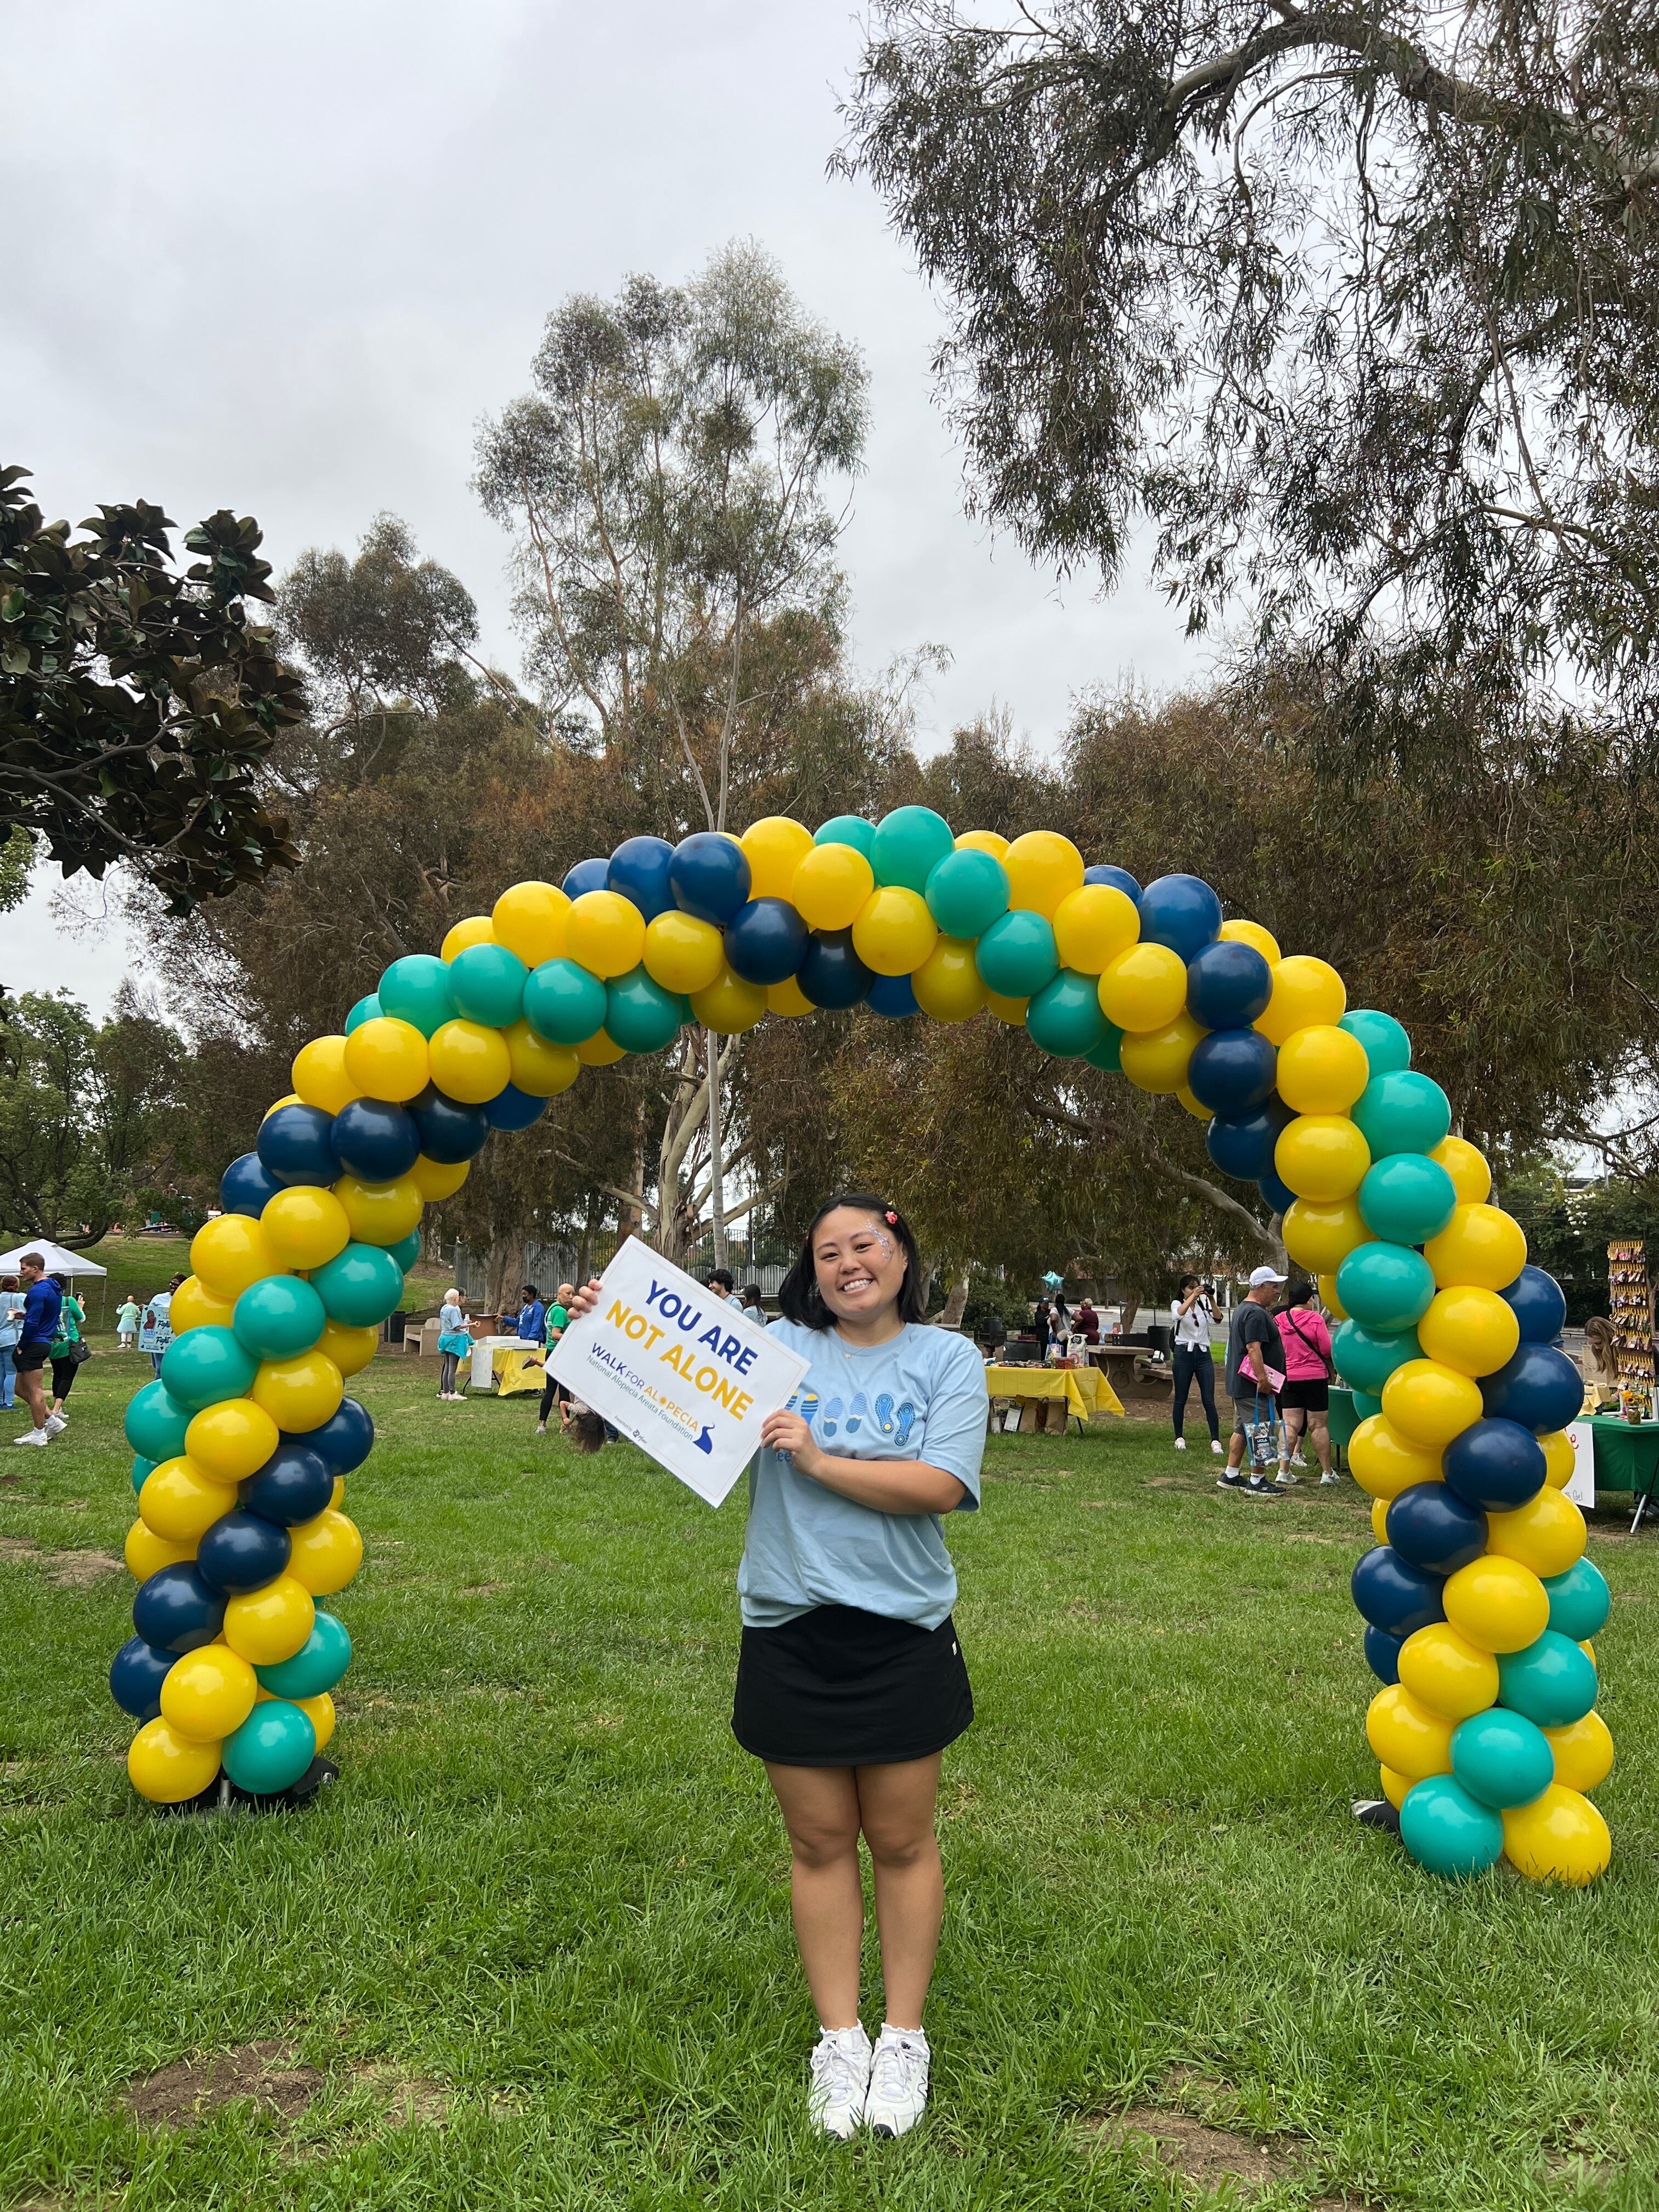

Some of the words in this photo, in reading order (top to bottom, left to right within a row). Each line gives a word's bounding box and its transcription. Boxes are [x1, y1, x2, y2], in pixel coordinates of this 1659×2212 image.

[592, 1342, 627, 1375] WALK
[625, 1370, 645, 1389] FOR
[606, 1299, 665, 1351] NOT
[659, 1344, 754, 1421] ALONE
[645, 1279, 703, 1332] YOU
[697, 1325, 758, 1376] ARE
[586, 1355, 612, 1378] National
[611, 1374, 638, 1398] Alopecia
[637, 1395, 658, 1414] Areata
[658, 1410, 693, 1440] Foundation
